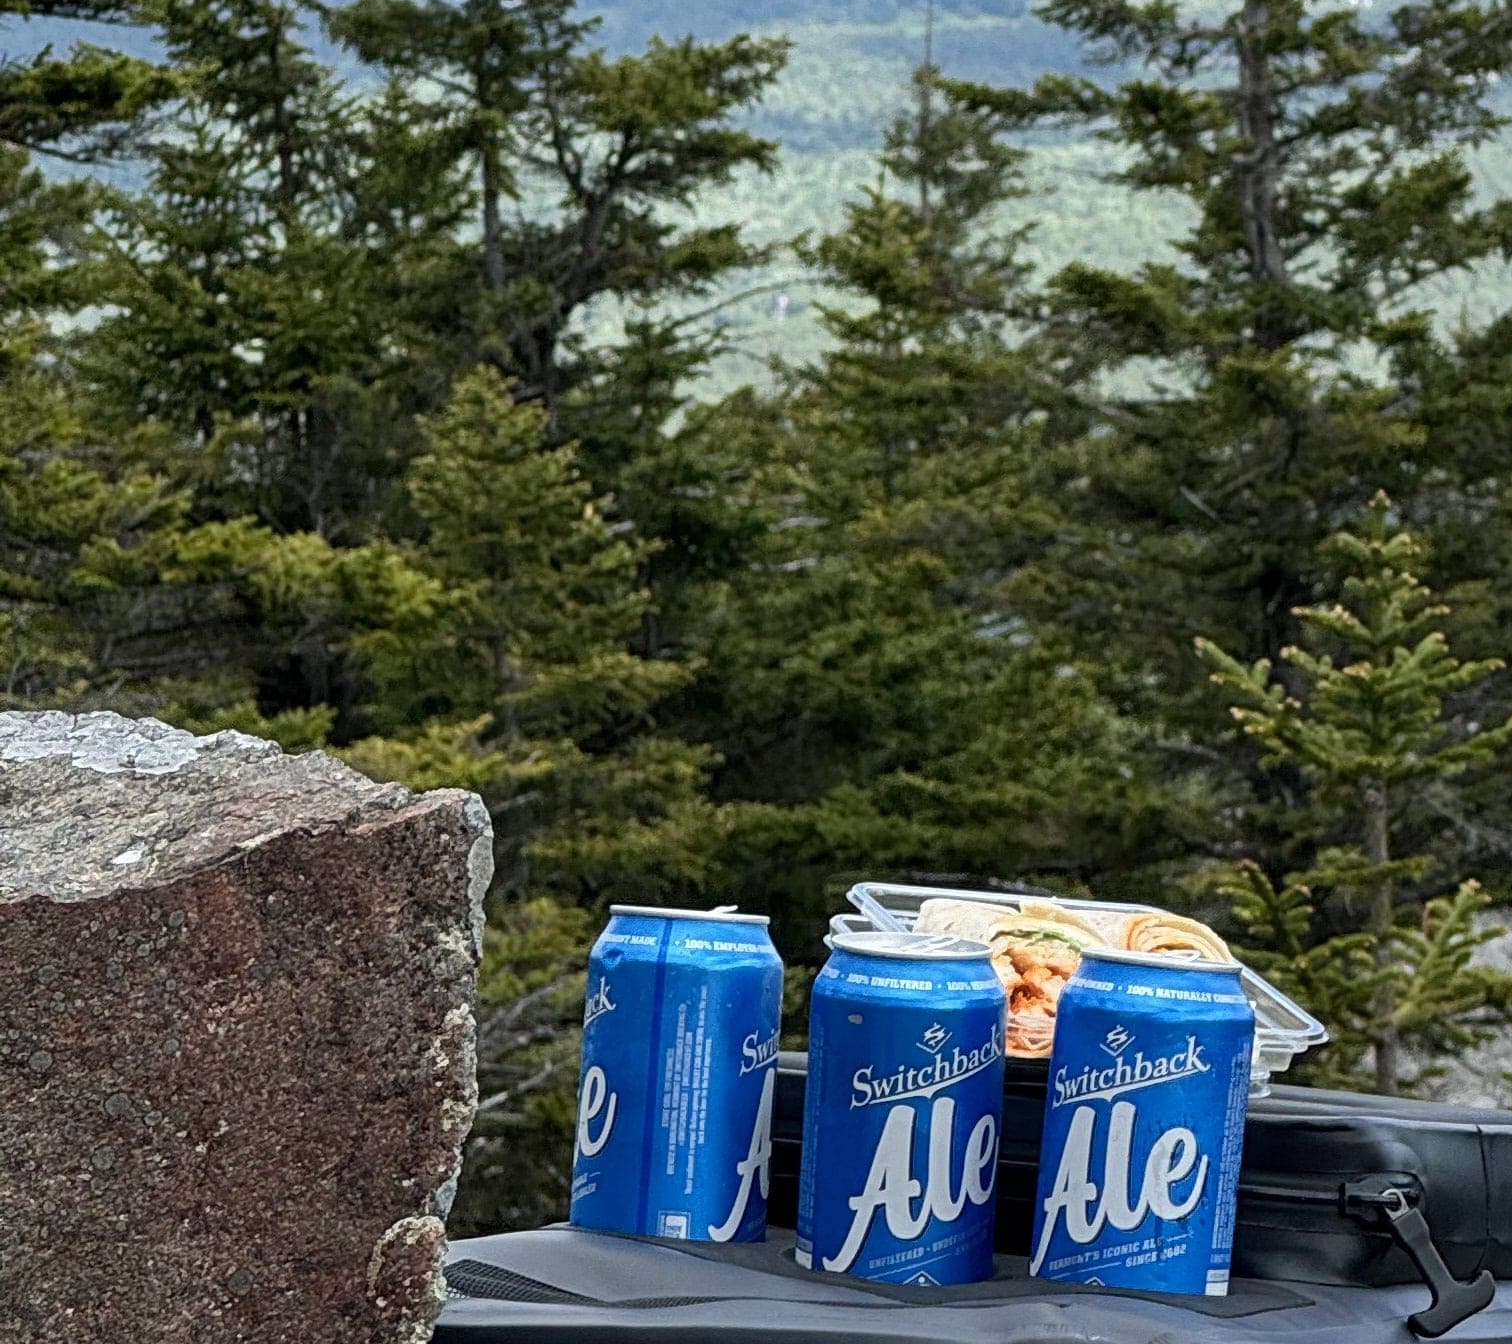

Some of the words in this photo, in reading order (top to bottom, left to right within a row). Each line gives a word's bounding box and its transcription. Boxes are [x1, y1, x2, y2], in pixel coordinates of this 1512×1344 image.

[684, 939, 712, 950] 100%
[871, 976, 932, 991] UNFILTERED
[1126, 984, 1154, 997] 100%
[1155, 988, 1212, 1003] NATURALLY
[850, 1024, 1003, 1110] Switchback
[1053, 1035, 1210, 1109] Switchback
[823, 1097, 999, 1272] Ale
[1030, 1101, 1208, 1276] Ale
[1103, 1242, 1140, 1258] ICONIC
[1125, 1251, 1157, 1268] SINCE
